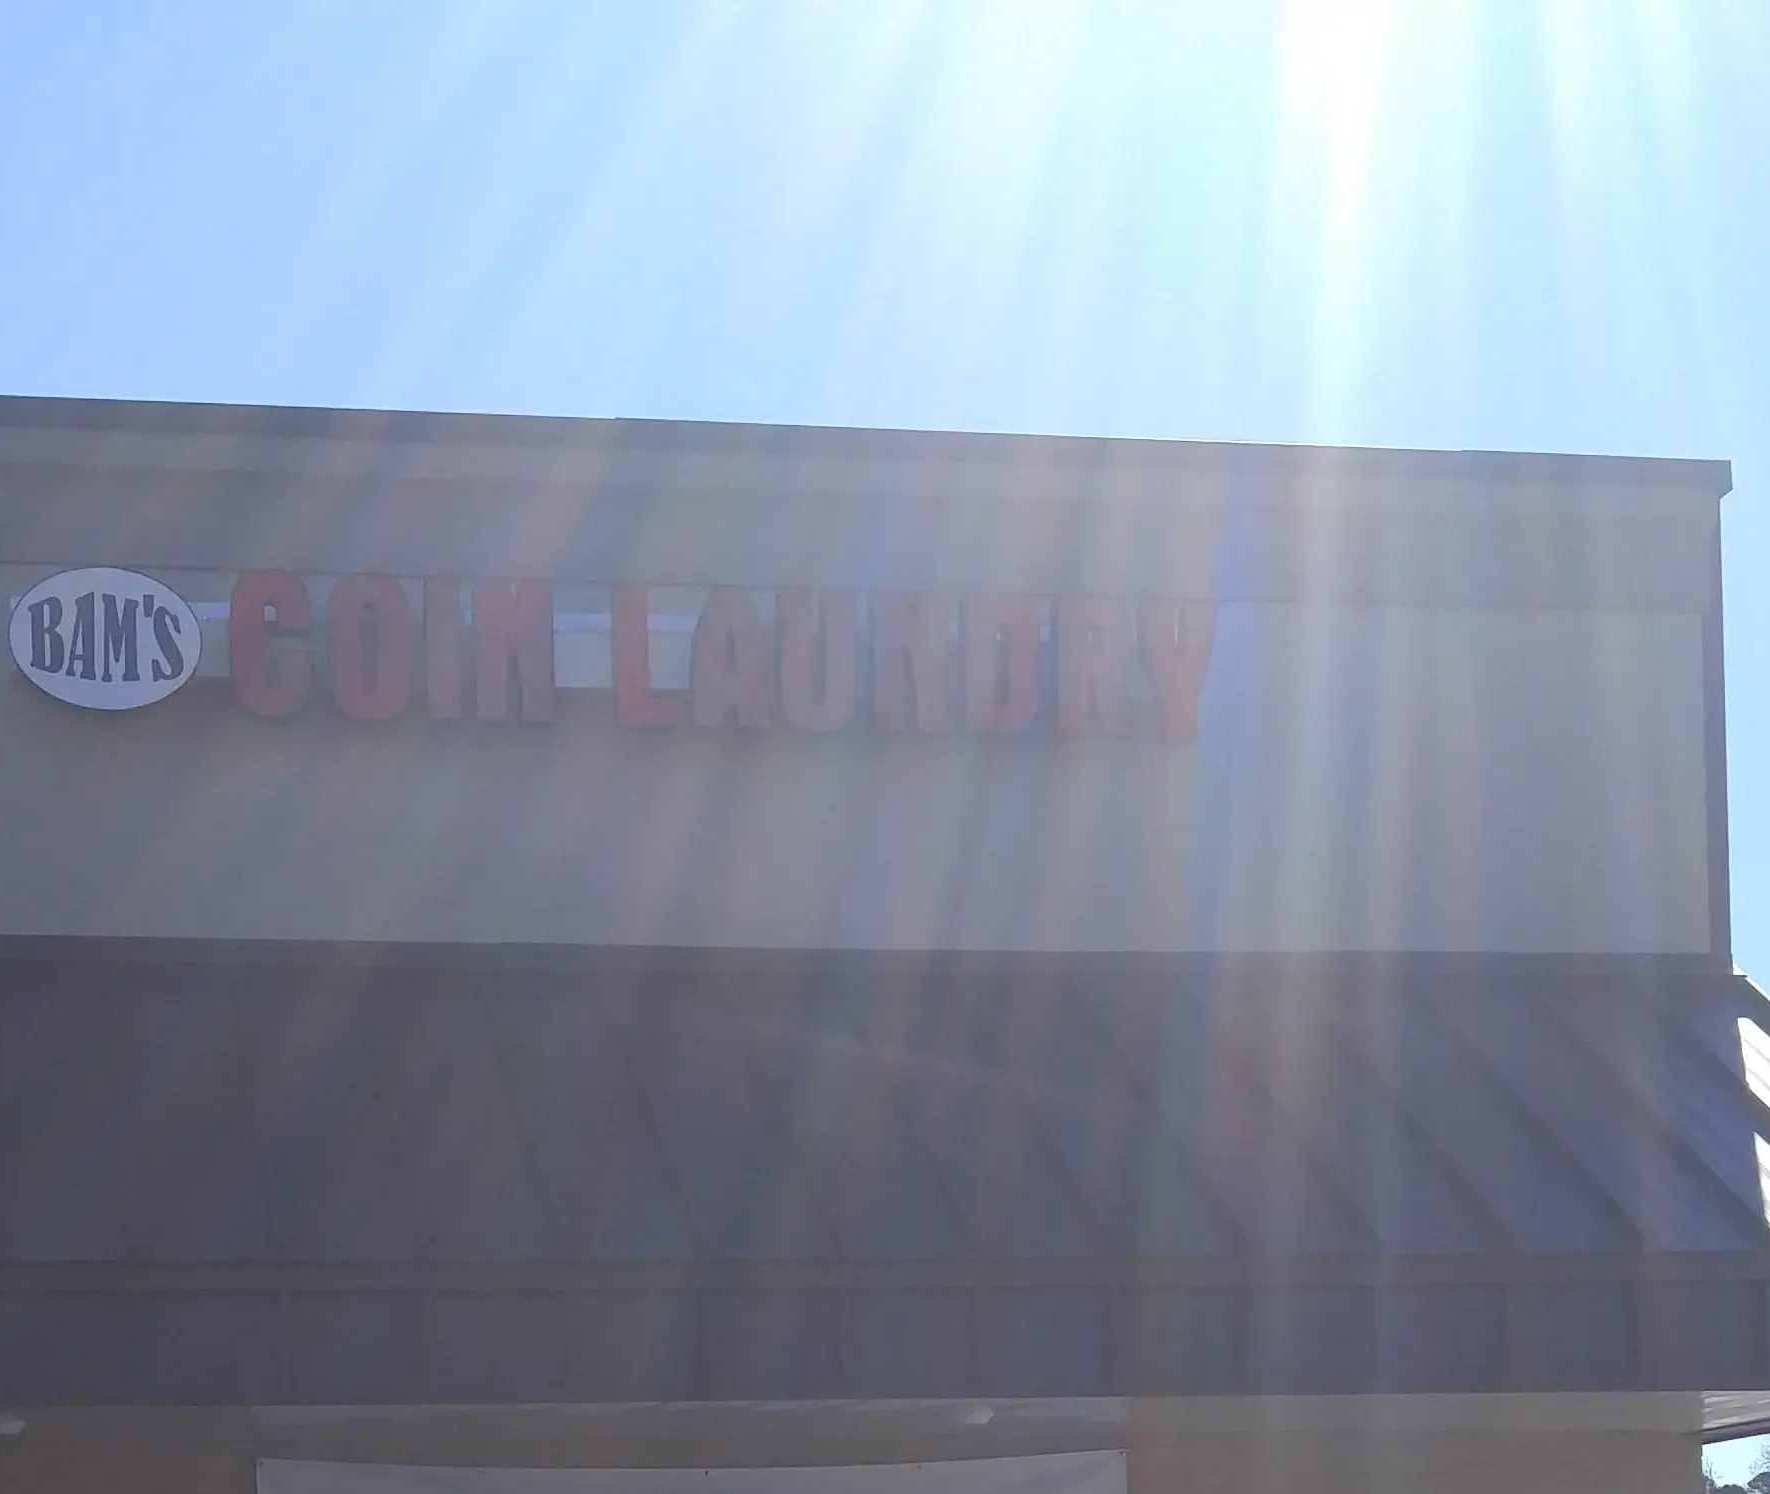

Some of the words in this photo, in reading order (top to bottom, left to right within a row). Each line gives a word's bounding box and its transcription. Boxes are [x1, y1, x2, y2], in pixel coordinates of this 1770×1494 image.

[27, 592, 188, 684] BAM'S
[230, 568, 558, 726] COIN
[612, 580, 1217, 740] LAUNDRY
